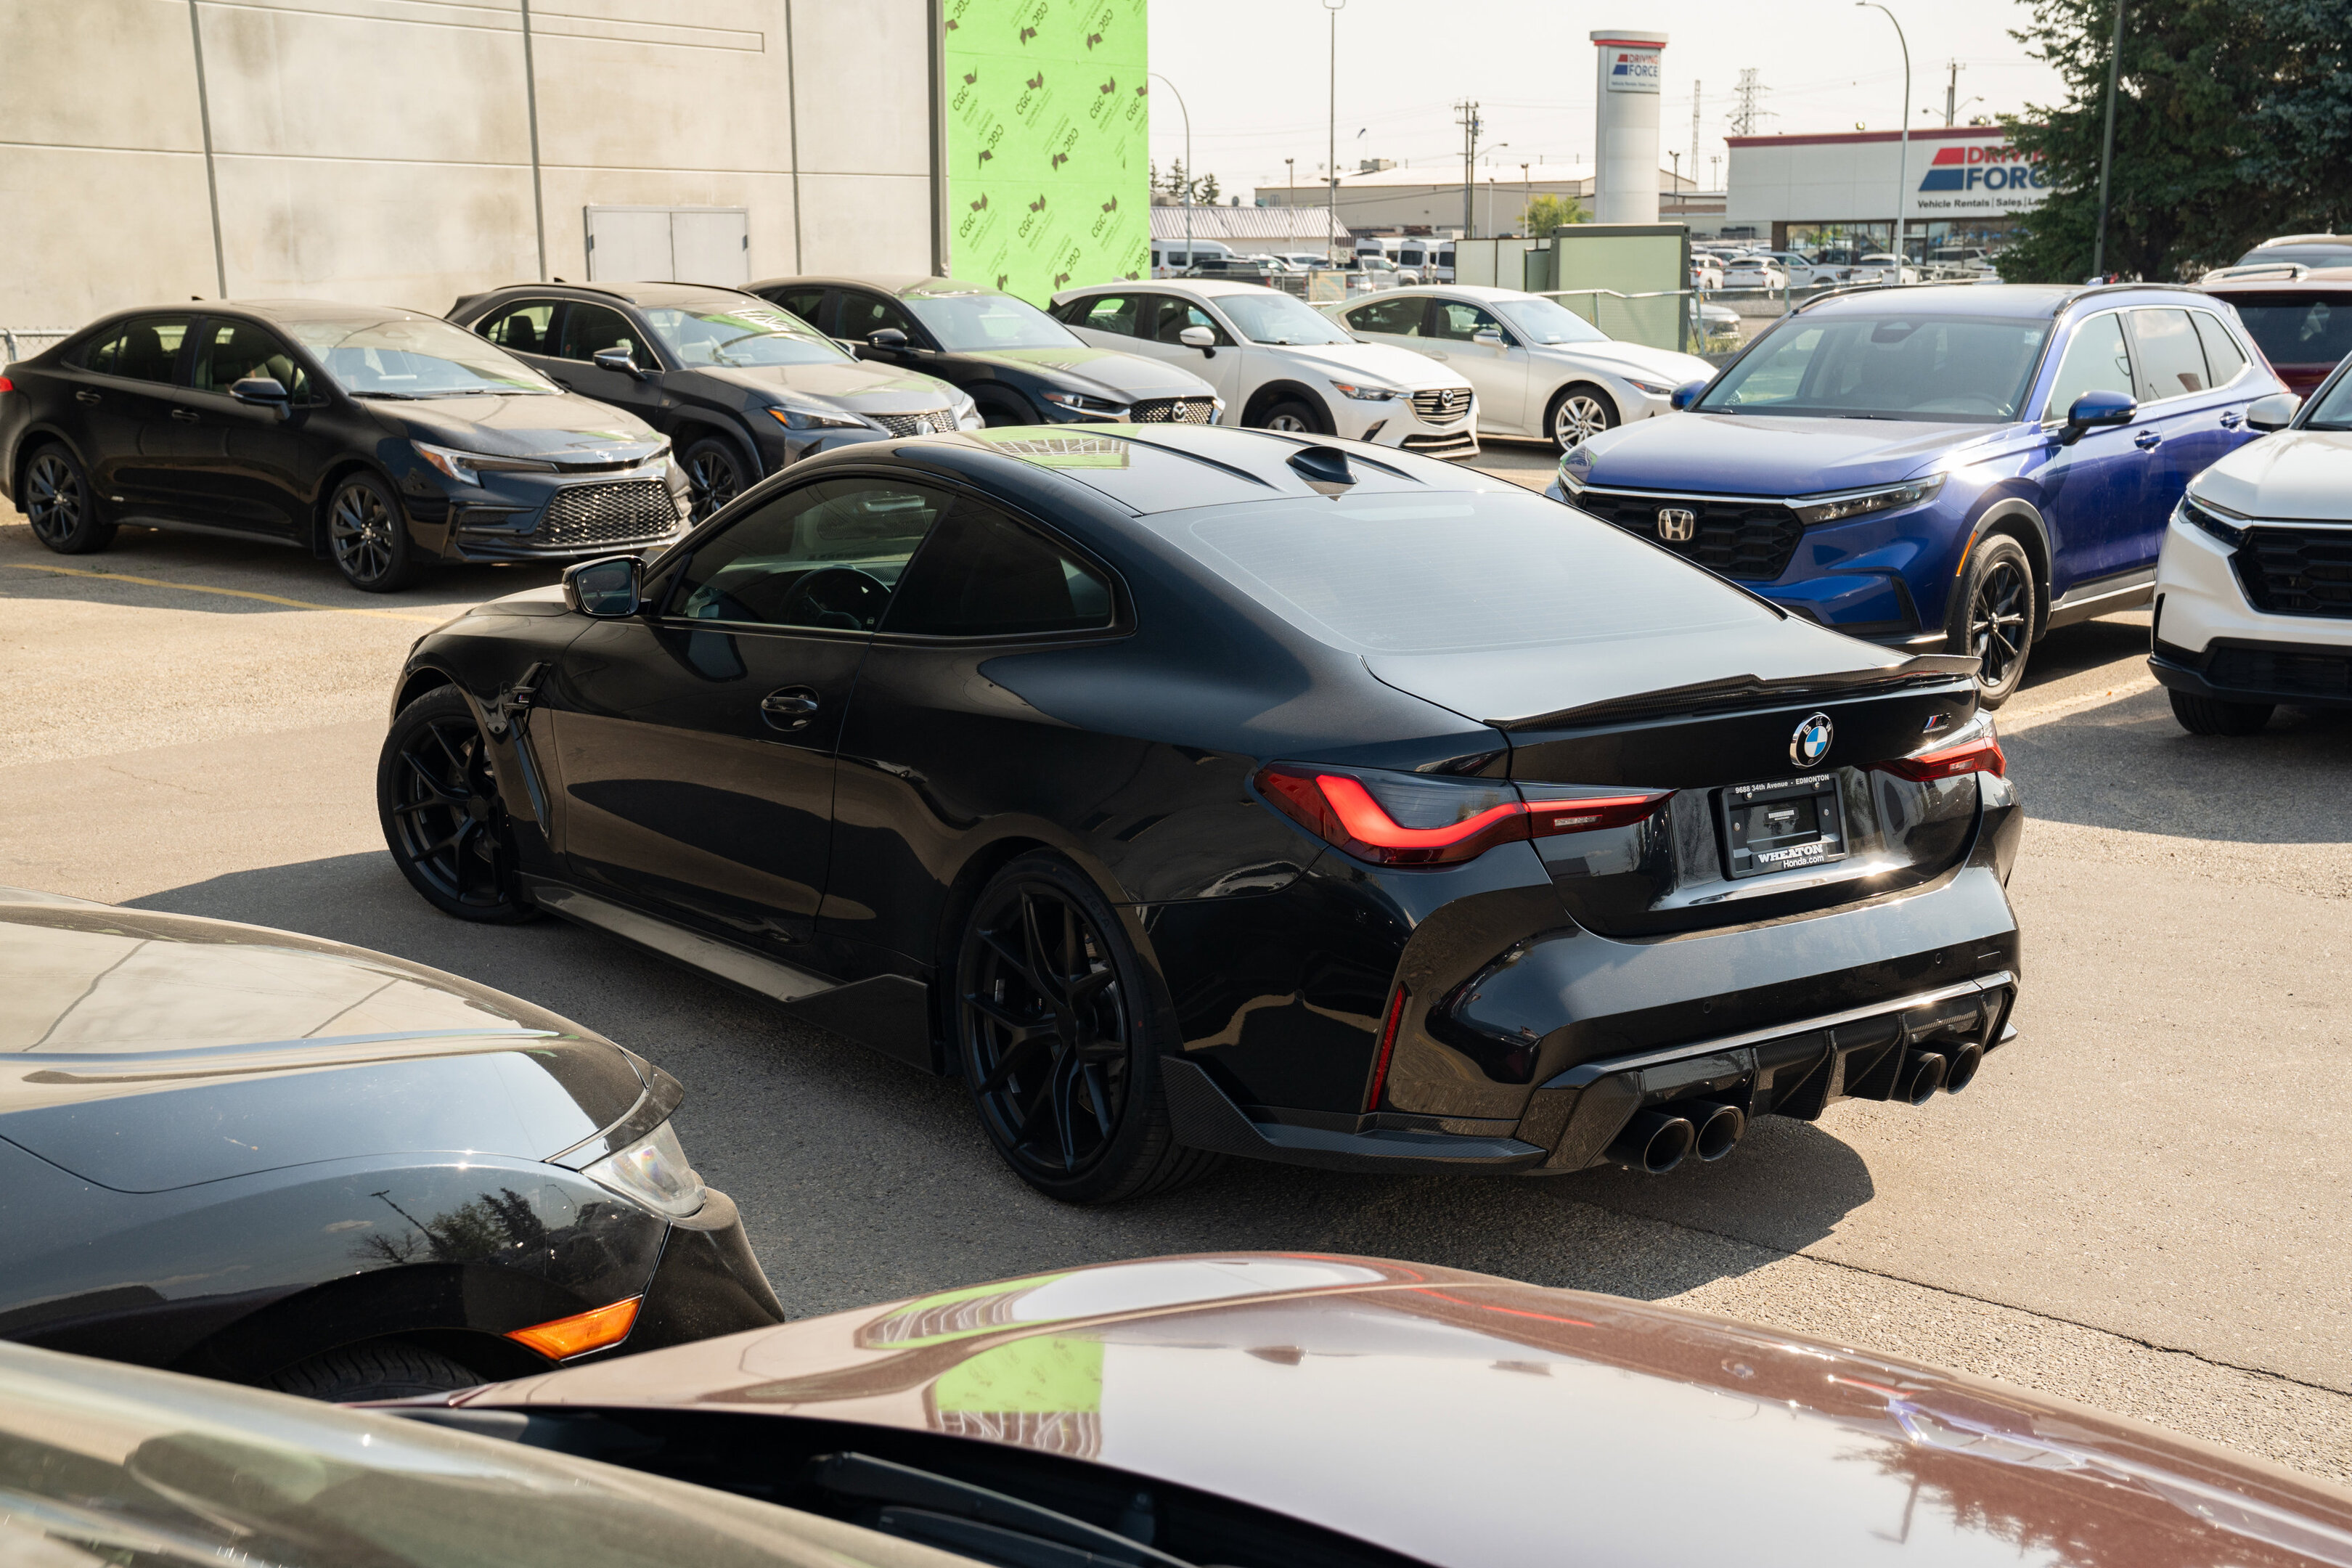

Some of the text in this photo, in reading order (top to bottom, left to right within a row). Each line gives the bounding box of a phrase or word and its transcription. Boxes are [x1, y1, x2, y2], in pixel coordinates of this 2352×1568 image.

[1032, 1, 1048, 27] CGC
[1098, 8, 1114, 33] CGC
[1628, 54, 1659, 65] DRIVING
[1628, 64, 1658, 77] FORCE
[952, 86, 970, 111] CGC
[1016, 90, 1032, 115] CGC
[1090, 95, 1106, 120] CGC
[1125, 97, 1141, 121] CGC
[987, 123, 1004, 150] CGC
[1063, 128, 1079, 152] CGC
[1966, 166, 2063, 191] FORC
[1917, 199, 1951, 208] Vehicle
[1953, 198, 1990, 208] Rentals
[1996, 197, 2022, 207] Sales
[959, 213, 976, 238] CGC
[1018, 213, 1034, 239] CGC
[1091, 213, 1107, 238] CGC
[1065, 247, 1081, 272] CGC
[1735, 785, 1750, 794] 9688
[1752, 783, 1765, 792] 34th
[1766, 780, 1789, 790] Avenue
[1795, 774, 1829, 785] EDMONTON
[1757, 844, 1824, 863] WHEATON
[1783, 855, 1824, 869] Honda.com
